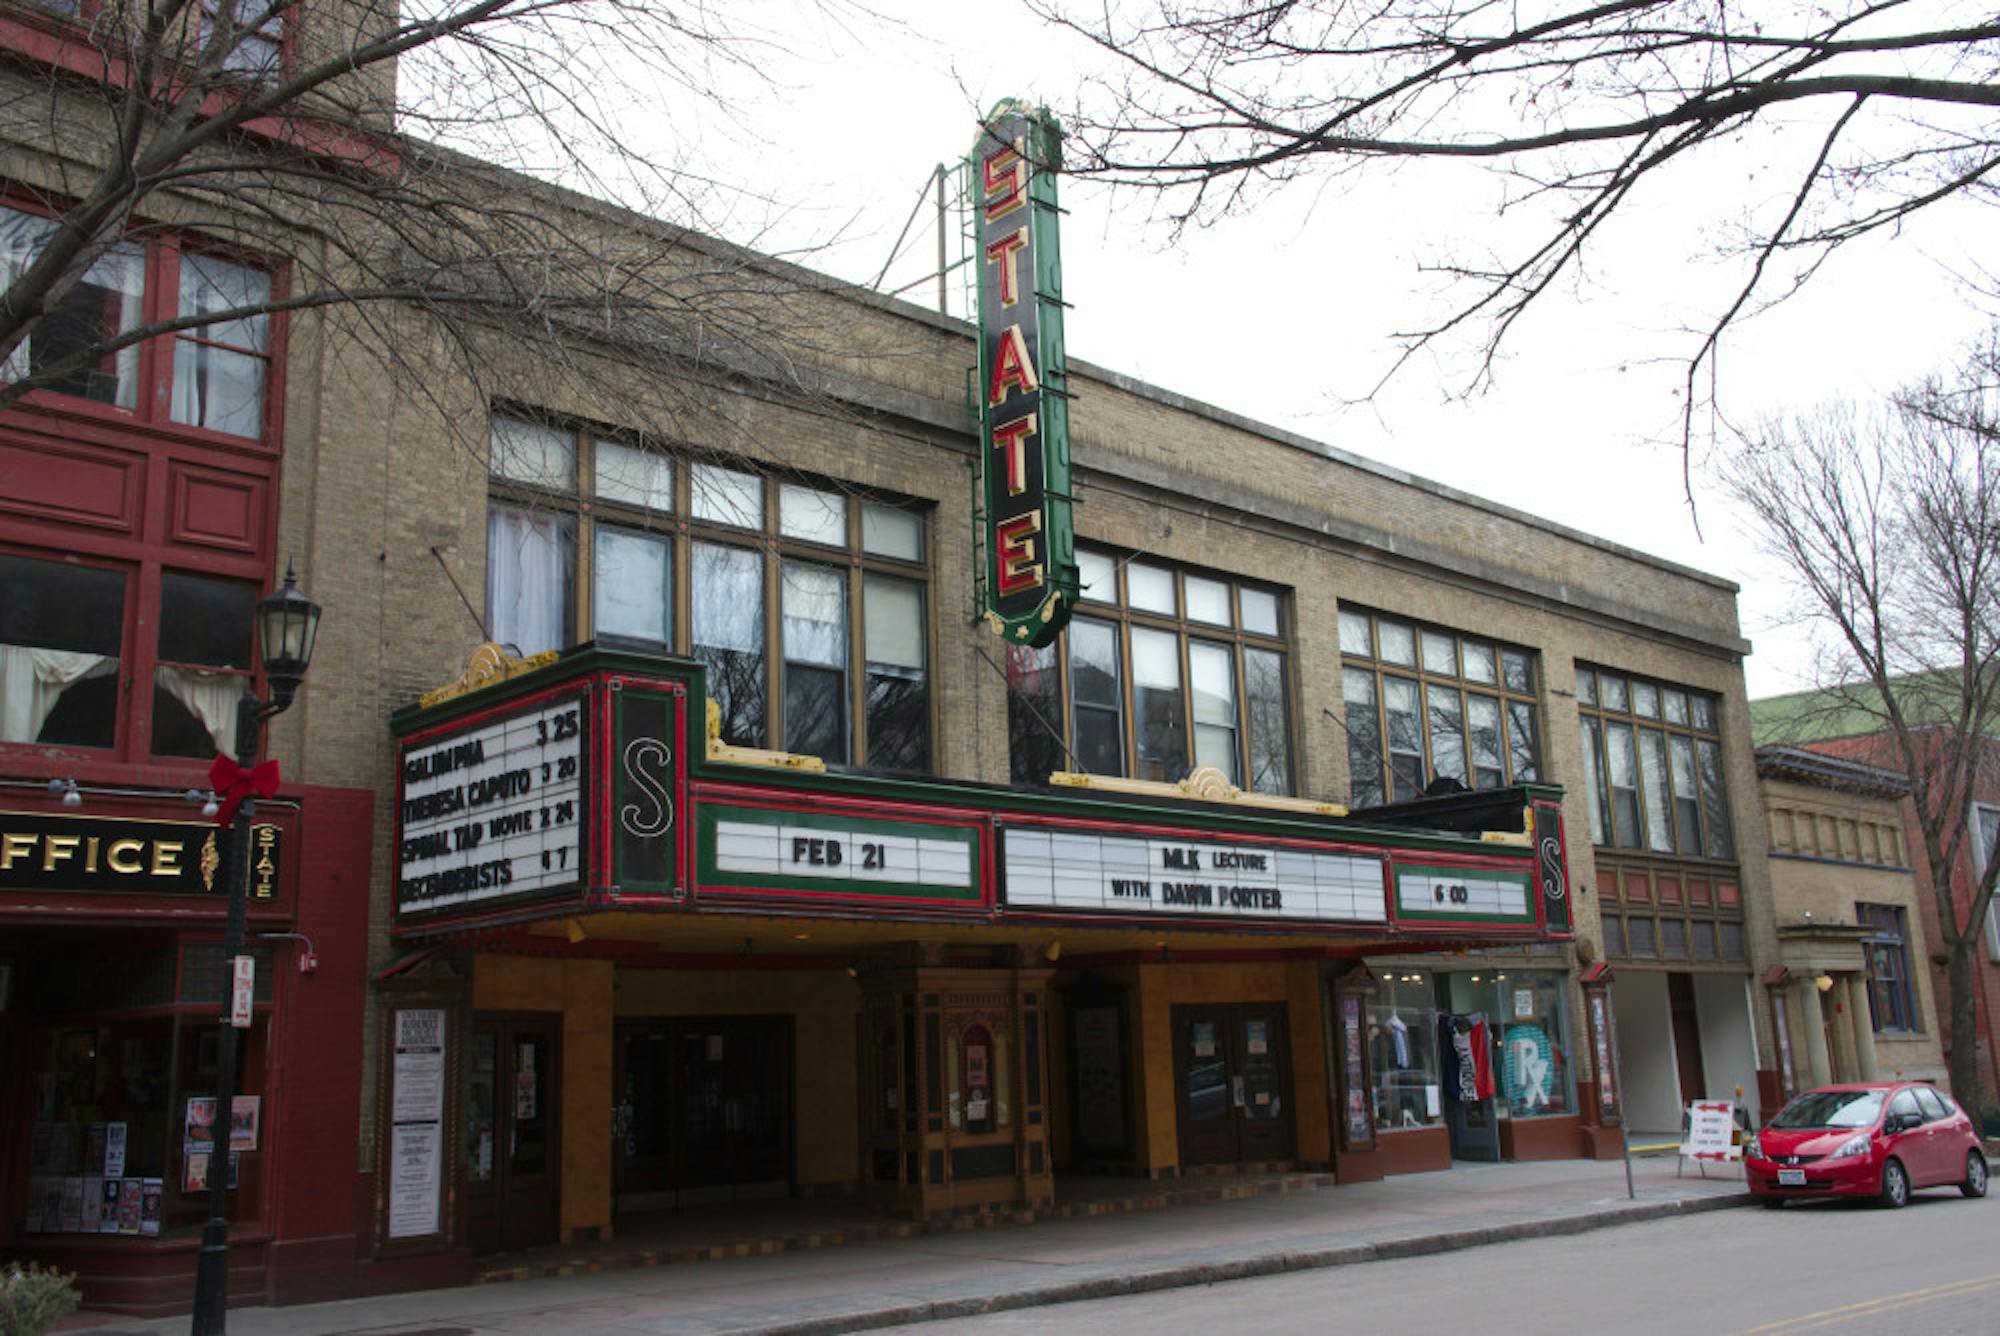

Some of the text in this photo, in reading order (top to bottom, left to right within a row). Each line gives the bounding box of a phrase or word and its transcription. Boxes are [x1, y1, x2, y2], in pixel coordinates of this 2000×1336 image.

[985, 133, 1044, 597] STATE
[537, 719, 549, 746] 3
[554, 710, 579, 741] 25
[468, 768, 532, 806] CAPUTO
[455, 822, 483, 851] TAP
[490, 810, 533, 838] MOVIE
[257, 827, 276, 898] STATE
[558, 846, 568, 869] 7
[793, 837, 885, 869] FEB 21
[1163, 847, 1267, 872] MLK LECTURE
[1112, 879, 1282, 910] WITH DAWN PORTER
